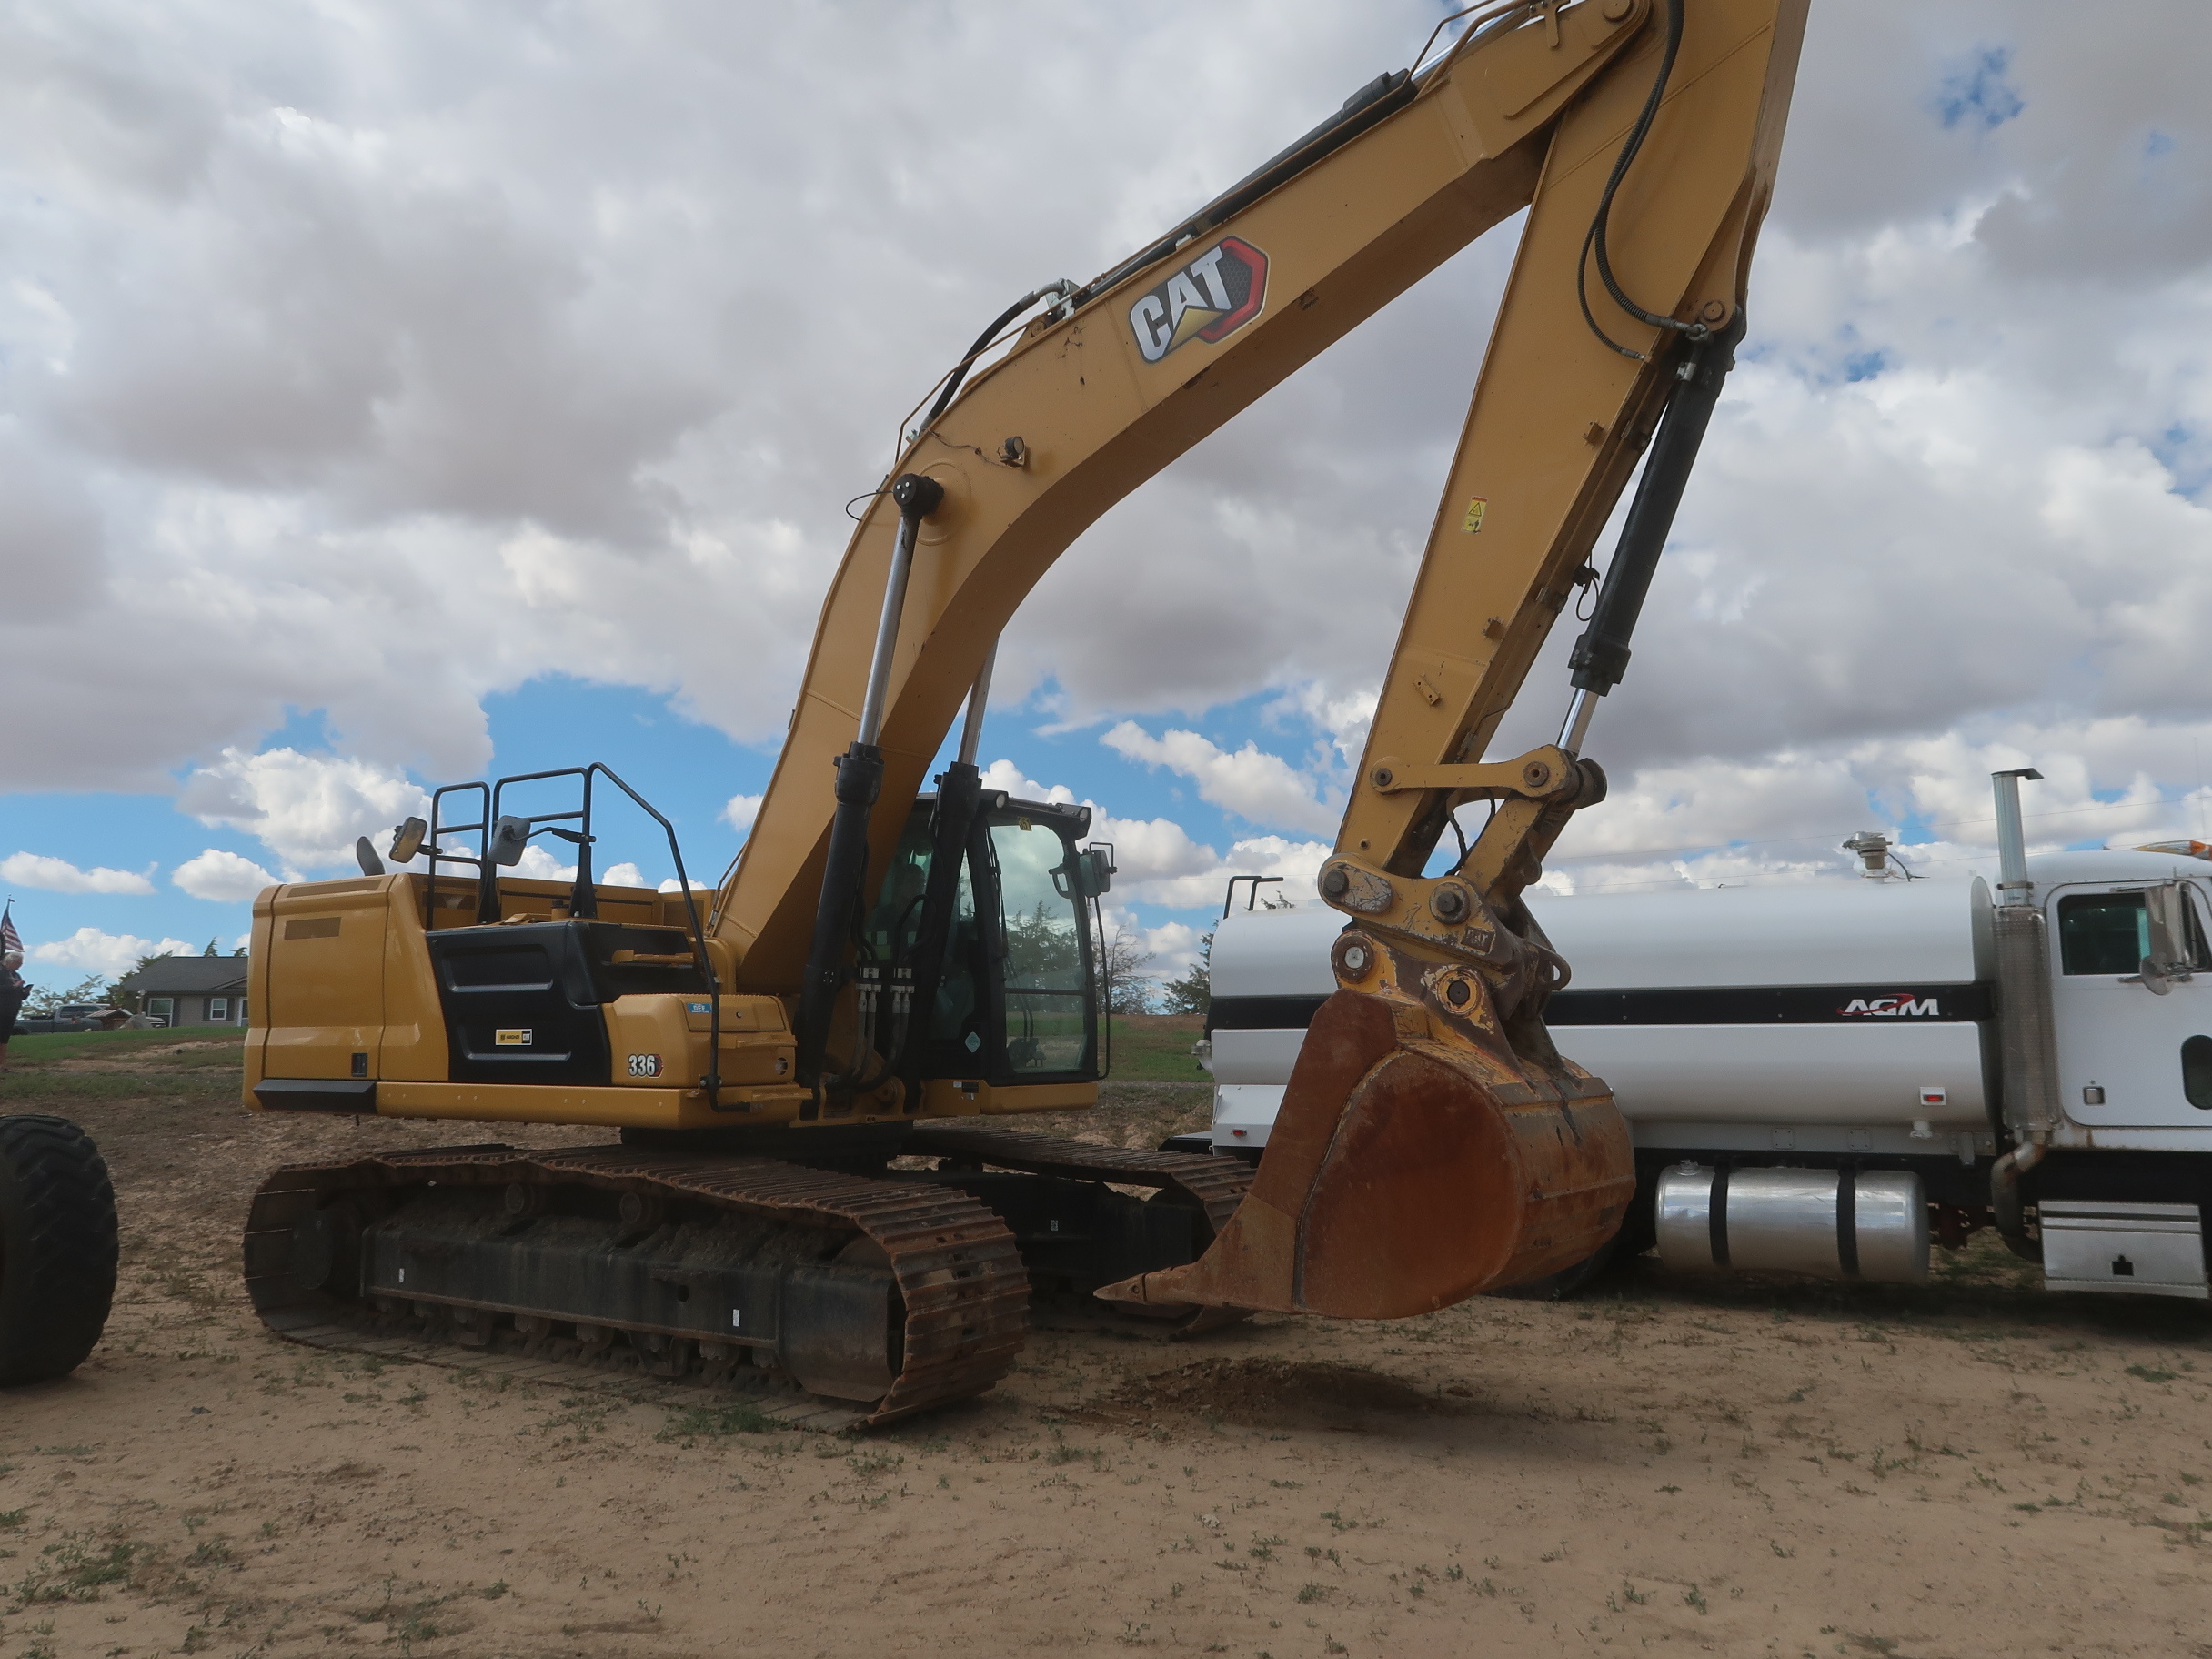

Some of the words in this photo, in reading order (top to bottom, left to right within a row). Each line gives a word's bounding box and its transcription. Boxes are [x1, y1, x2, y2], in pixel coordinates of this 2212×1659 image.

[1131, 246, 1232, 361] CAT
[1842, 998, 1939, 1016] AGM
[628, 1055, 655, 1076] 336
